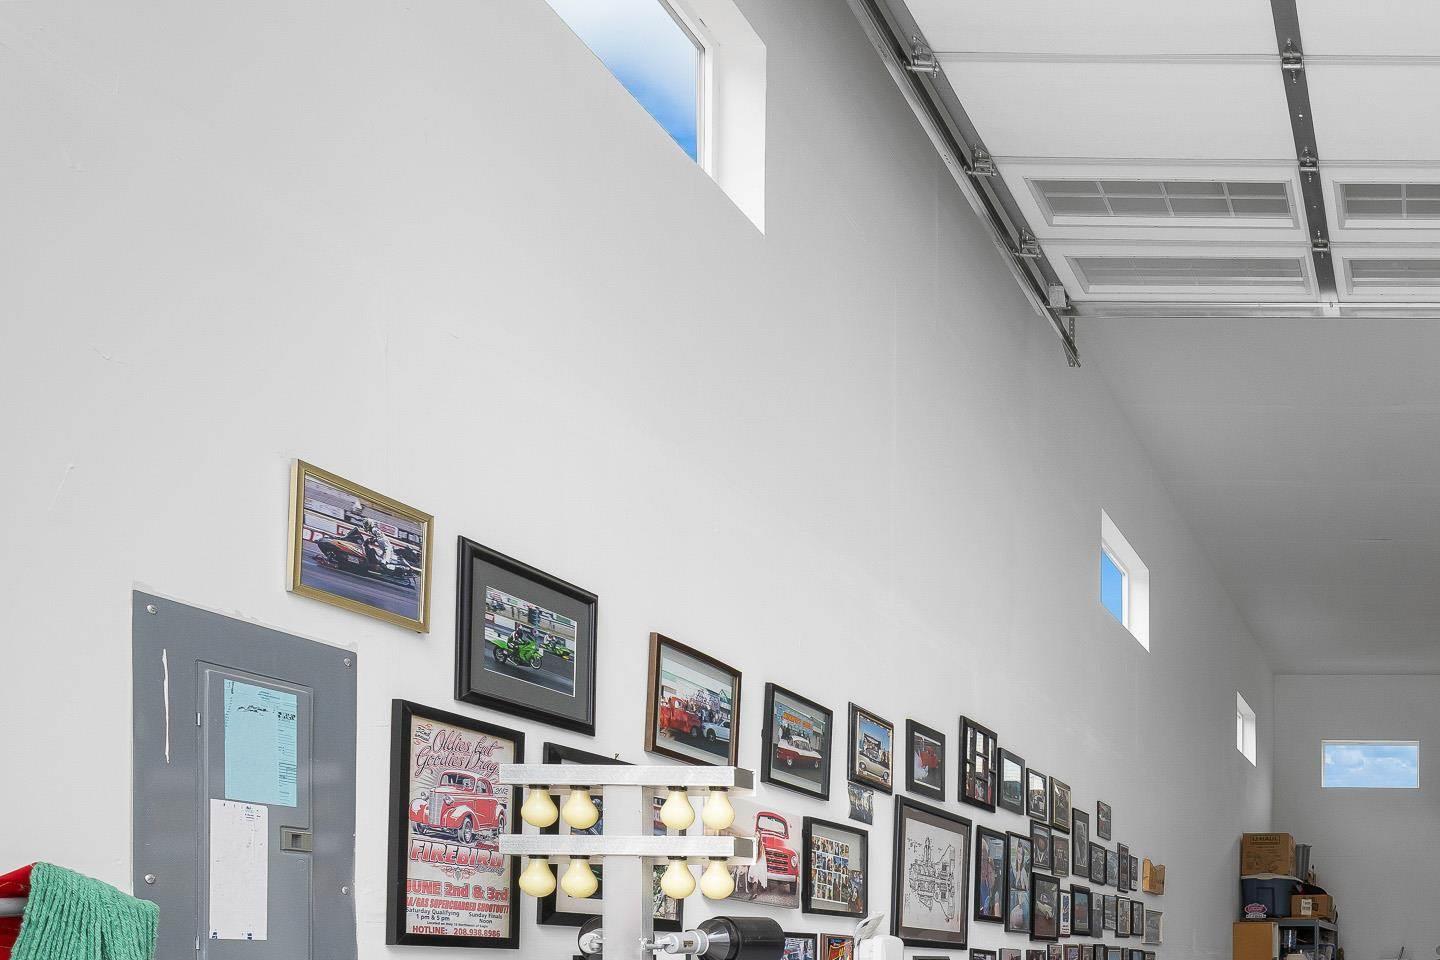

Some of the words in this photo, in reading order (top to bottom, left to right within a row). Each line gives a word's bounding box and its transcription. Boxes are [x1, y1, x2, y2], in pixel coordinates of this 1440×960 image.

[433, 730, 472, 754] Oldies
[475, 736, 504, 757] but
[415, 746, 465, 778] Goodies
[411, 840, 504, 868] FIREBIRD
[407, 880, 441, 896] JUNE
[444, 882, 470, 899] 2nd
[473, 885, 485, 899] &
[487, 887, 509, 901] 3rd
[406, 907, 431, 916] Saturday
[432, 909, 460, 917] Qualifying
[430, 898, 476, 912] SUPERCHARGED
[469, 911, 487, 919] Sunday
[413, 925, 447, 935] HOTLINE:
